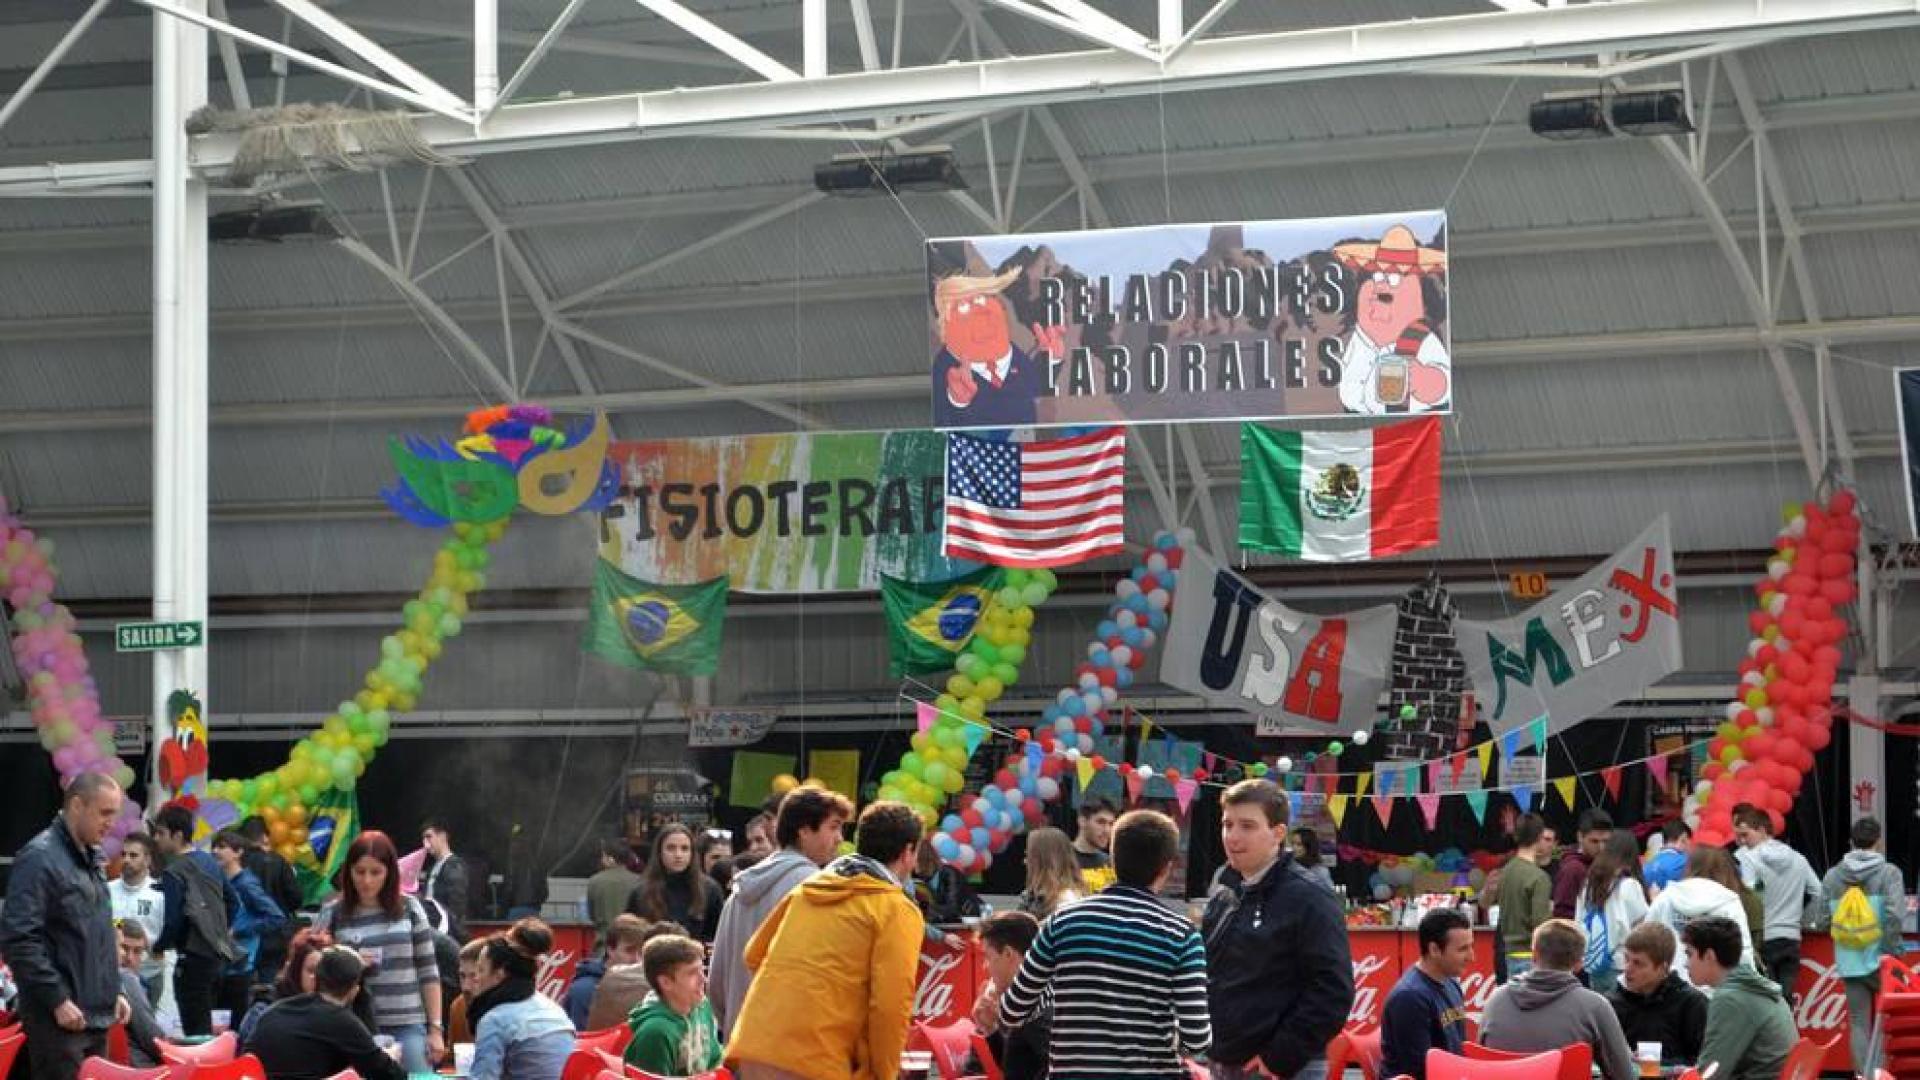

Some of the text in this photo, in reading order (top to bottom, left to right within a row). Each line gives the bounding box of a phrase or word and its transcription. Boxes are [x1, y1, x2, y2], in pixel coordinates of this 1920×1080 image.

[1039, 262, 1345, 326] RELACIONES
[1040, 335, 1346, 397] LABORALES
[1515, 574, 1544, 594] 10
[120, 626, 175, 647] SALIDA
[1200, 567, 1348, 724] USA
